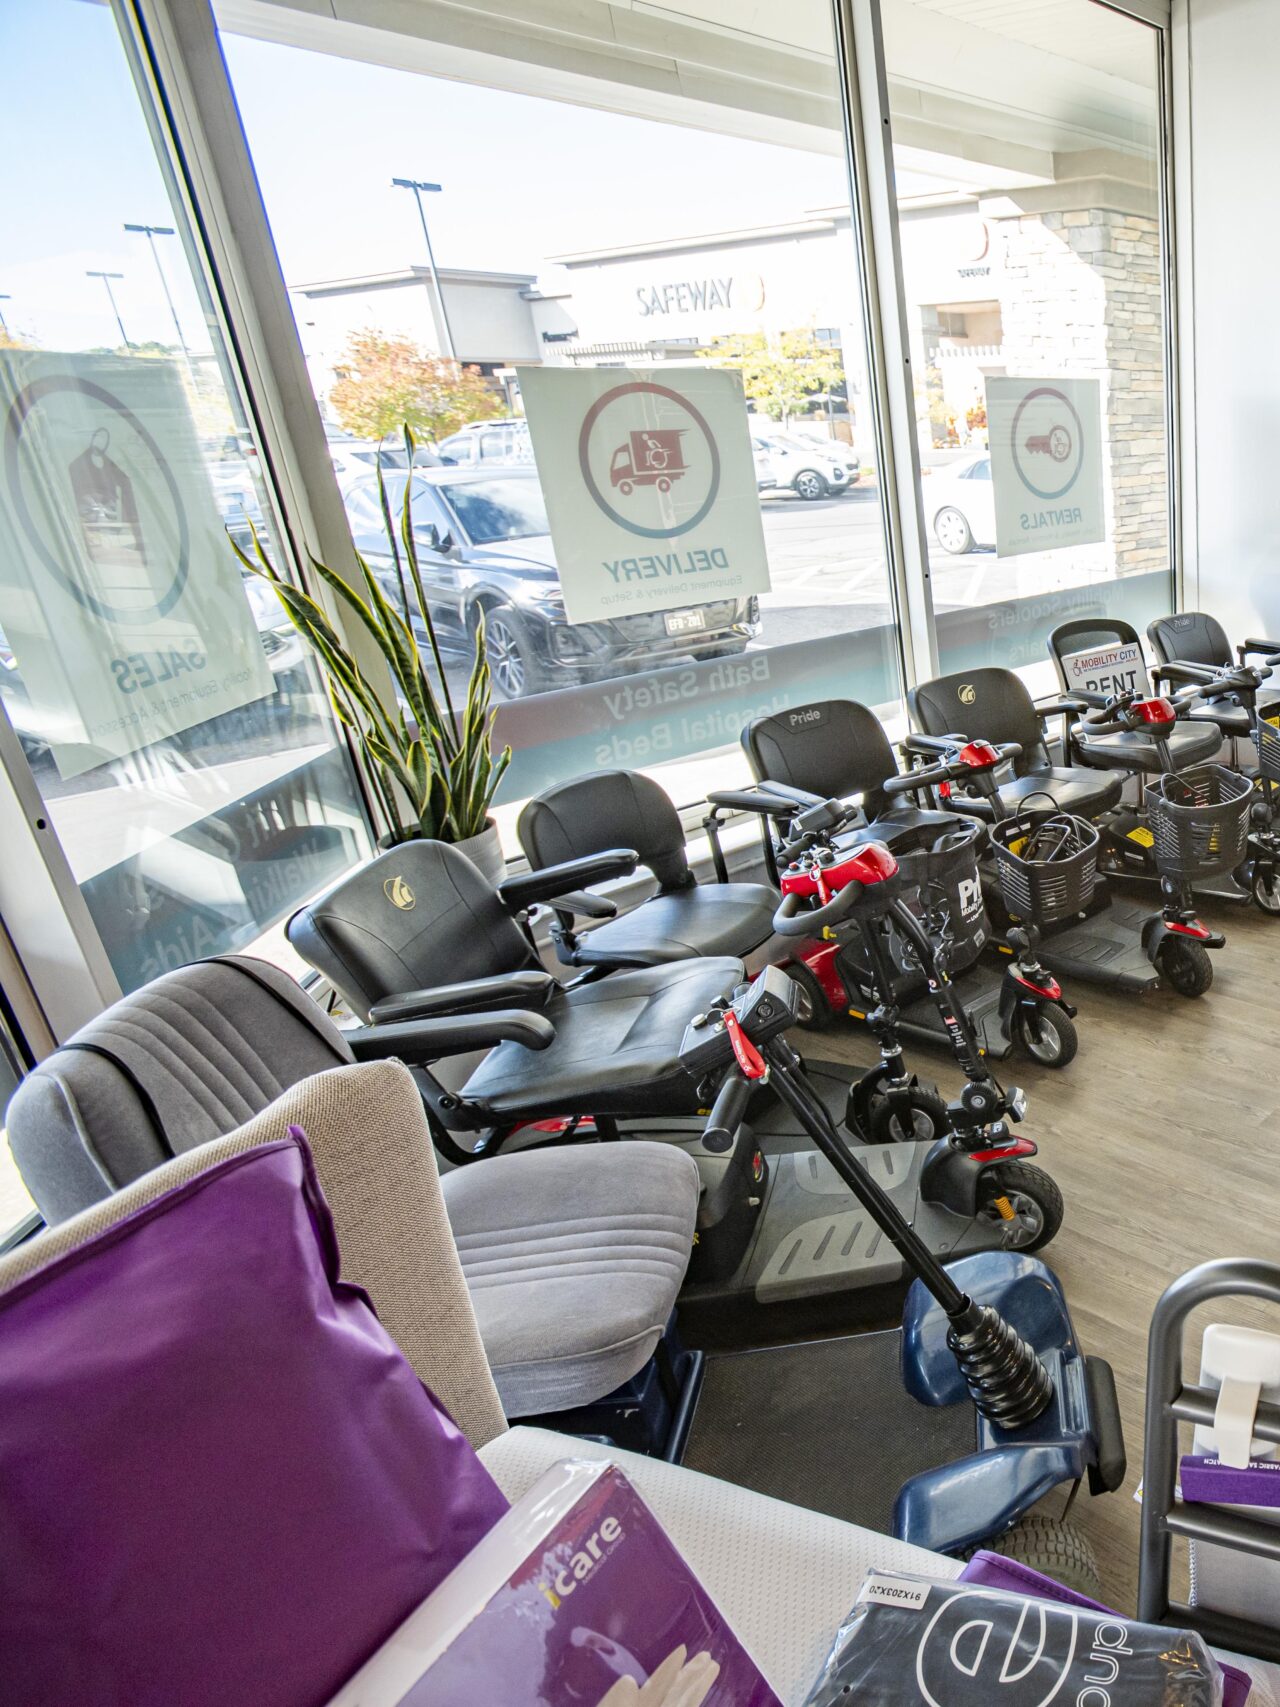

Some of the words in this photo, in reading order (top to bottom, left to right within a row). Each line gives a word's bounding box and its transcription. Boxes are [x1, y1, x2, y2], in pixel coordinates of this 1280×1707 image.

[637, 277, 732, 316] SAFEWAY
[1081, 653, 1118, 669] MOBILITY
[1120, 649, 1137, 660] CITY
[789, 709, 821, 726] Pride
[538, 1517, 622, 1610] icare
